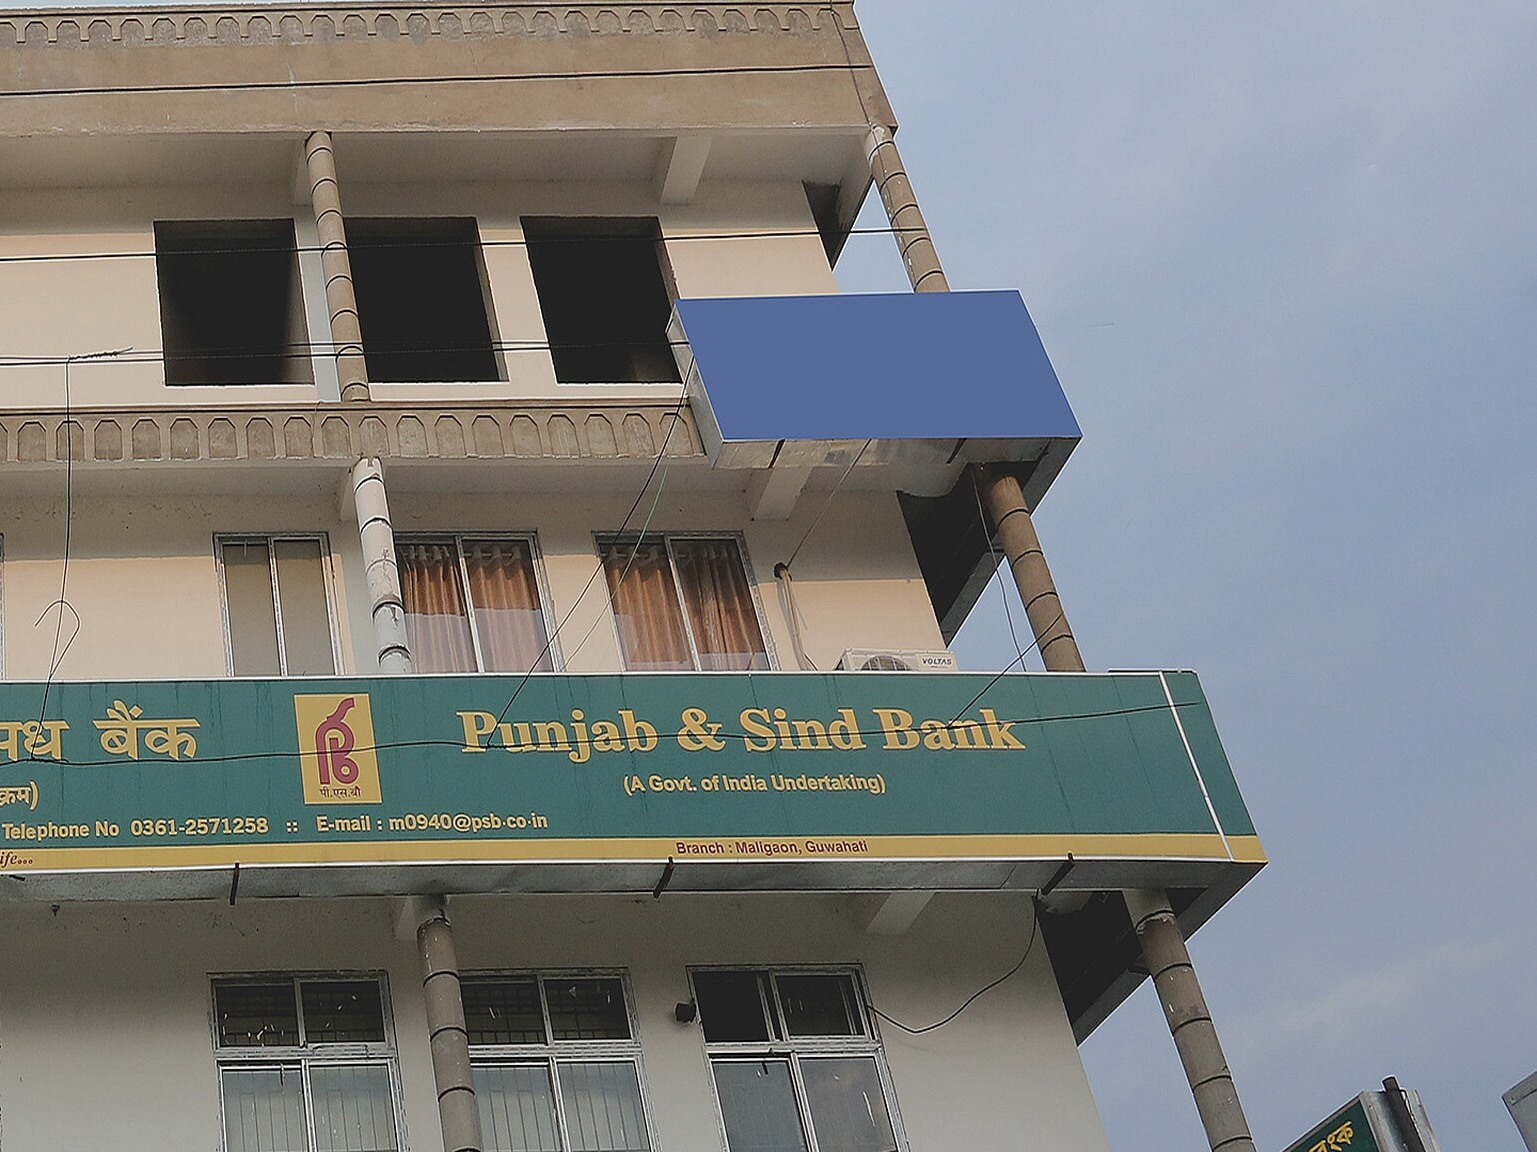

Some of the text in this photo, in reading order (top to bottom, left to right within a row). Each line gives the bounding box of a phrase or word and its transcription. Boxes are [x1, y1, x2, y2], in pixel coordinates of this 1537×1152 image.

[92, 700, 201, 760] बैंक
[456, 706, 1026, 763] Punjab & Sind Bank
[622, 773, 887, 797] (A Govt. of India Undertaking)
[1, 822, 90, 842] Telephone
[95, 821, 121, 838] No
[130, 817, 270, 836] 0361-2571258
[316, 815, 372, 833] E-mail
[676, 840, 868, 856] Branch Maligaon, Guwahati
